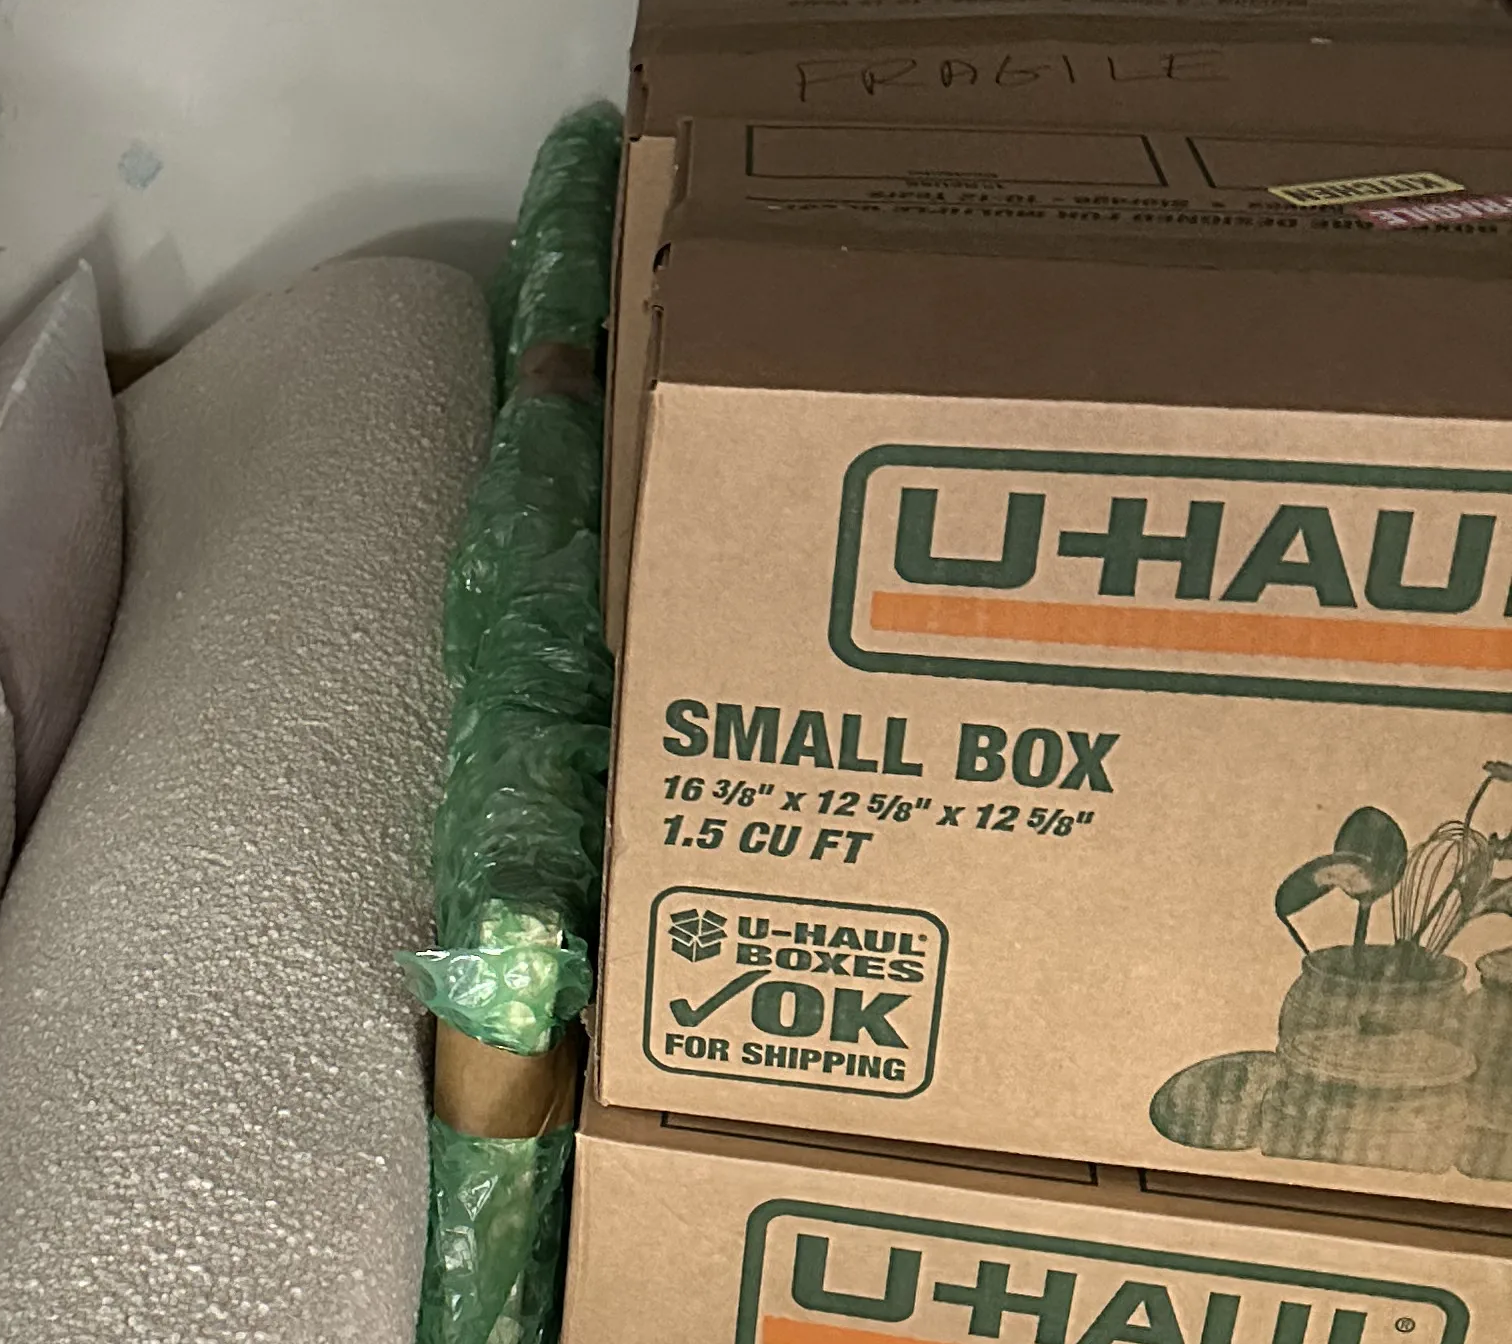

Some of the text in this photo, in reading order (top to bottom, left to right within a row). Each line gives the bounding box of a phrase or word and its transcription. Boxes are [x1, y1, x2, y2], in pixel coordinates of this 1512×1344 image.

[795, 51, 1230, 103] FRAGILE
[1287, 175, 1440, 204] KITCHEN
[892, 485, 1512, 619] U-HAU
[662, 698, 1121, 794] SMALL BOX
[662, 775, 1096, 839] 16 3/8" x 12 5/8" x 12 5/8"
[662, 814, 874, 865] 1.5 CU FT
[735, 941, 925, 984] BOXES
[736, 916, 926, 959] U-HAUL
[750, 979, 912, 1050] OK
[664, 1032, 907, 1083] FOR SHIPPING
